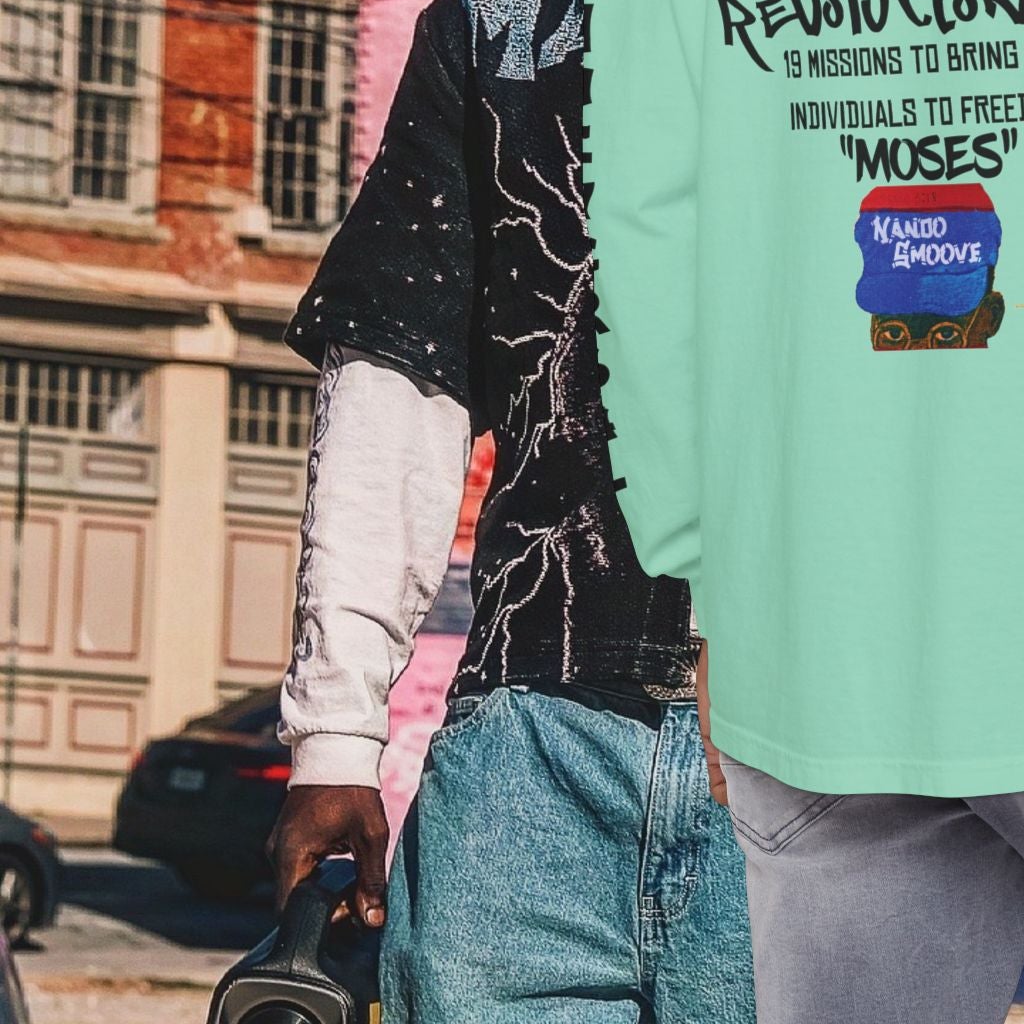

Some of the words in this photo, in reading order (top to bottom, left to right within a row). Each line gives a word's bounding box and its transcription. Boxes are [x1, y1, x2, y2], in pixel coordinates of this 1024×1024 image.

[784, 50, 801, 78] 19
[808, 47, 902, 77] MISSIONS
[910, 44, 939, 73] TO
[947, 41, 1018, 71] BRING
[791, 99, 916, 130] INDIVIDUALS
[924, 97, 953, 126] TO
[840, 128, 1017, 182] "MOSES"
[871, 215, 947, 244] NANDO
[892, 239, 981, 269] SMOOVE
